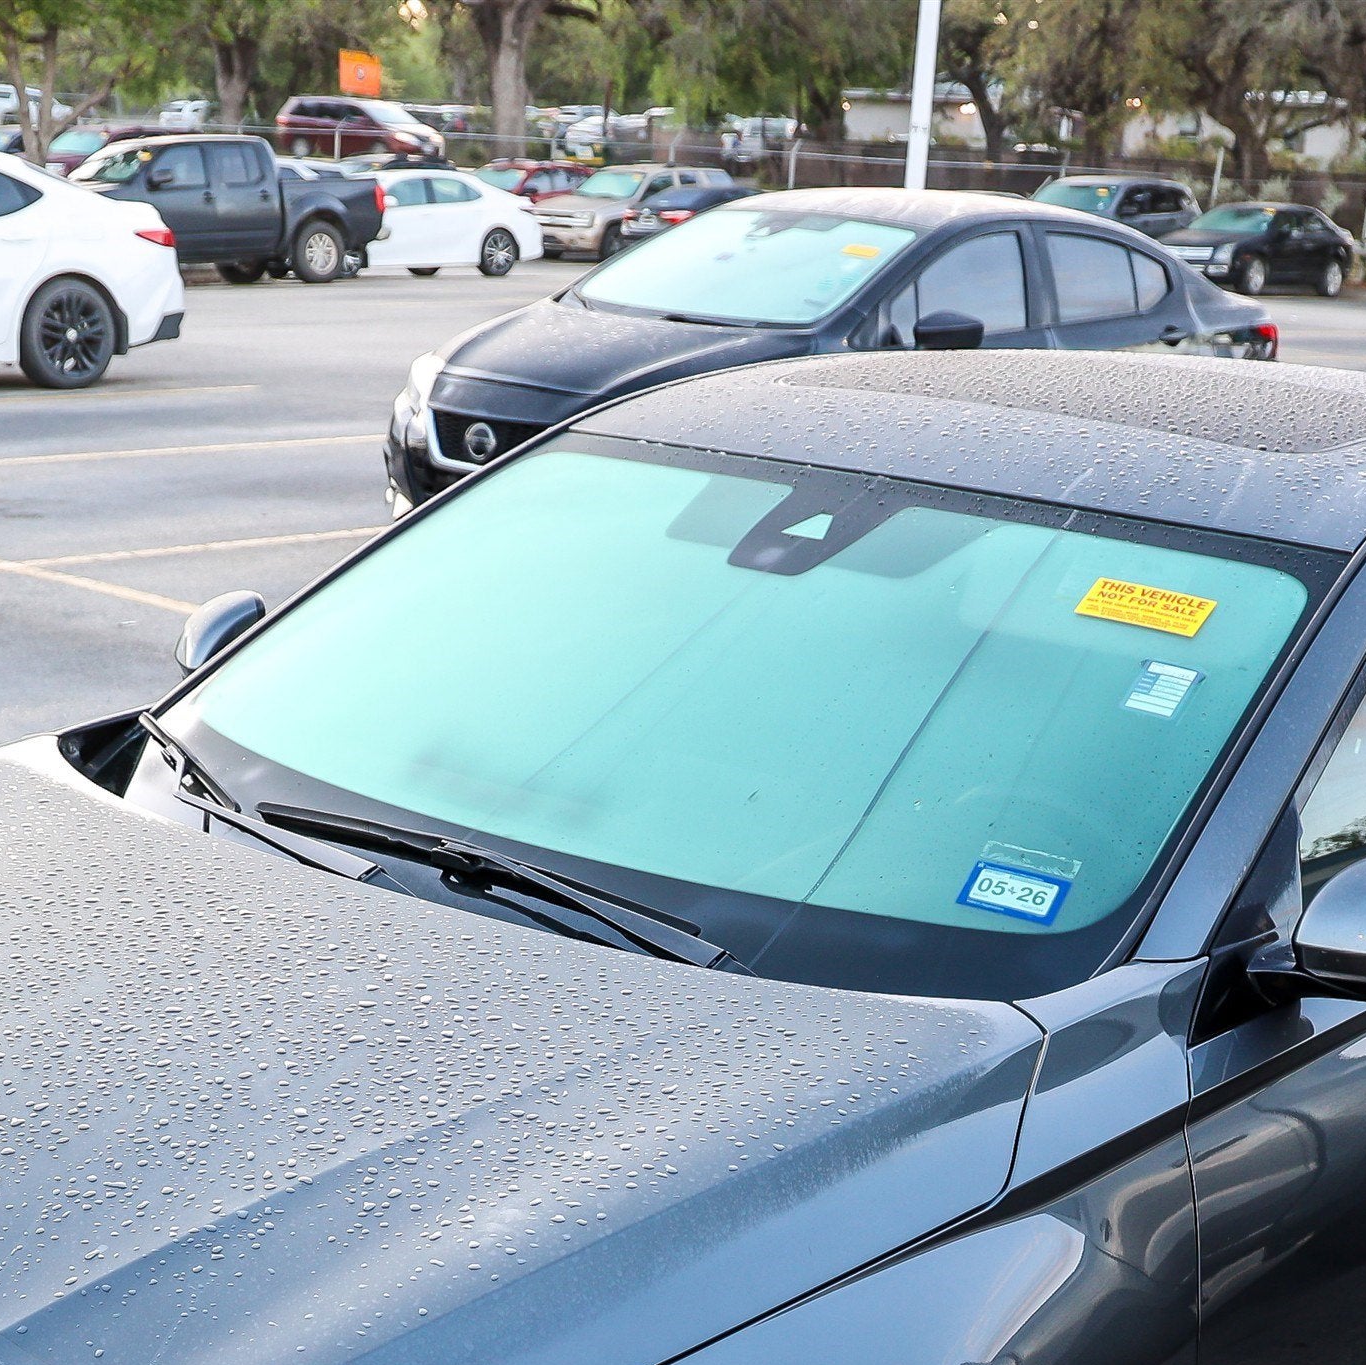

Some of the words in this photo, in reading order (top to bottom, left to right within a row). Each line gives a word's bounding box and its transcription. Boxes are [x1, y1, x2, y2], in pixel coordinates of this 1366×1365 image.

[1097, 591, 1126, 601] NOT
[1129, 596, 1158, 608] FOR
[1160, 603, 1199, 616] SALE
[1100, 580, 1136, 594] THIS
[1141, 588, 1208, 610] VEHICLE
[977, 877, 1009, 896] 05
[1015, 886, 1049, 906] 26
